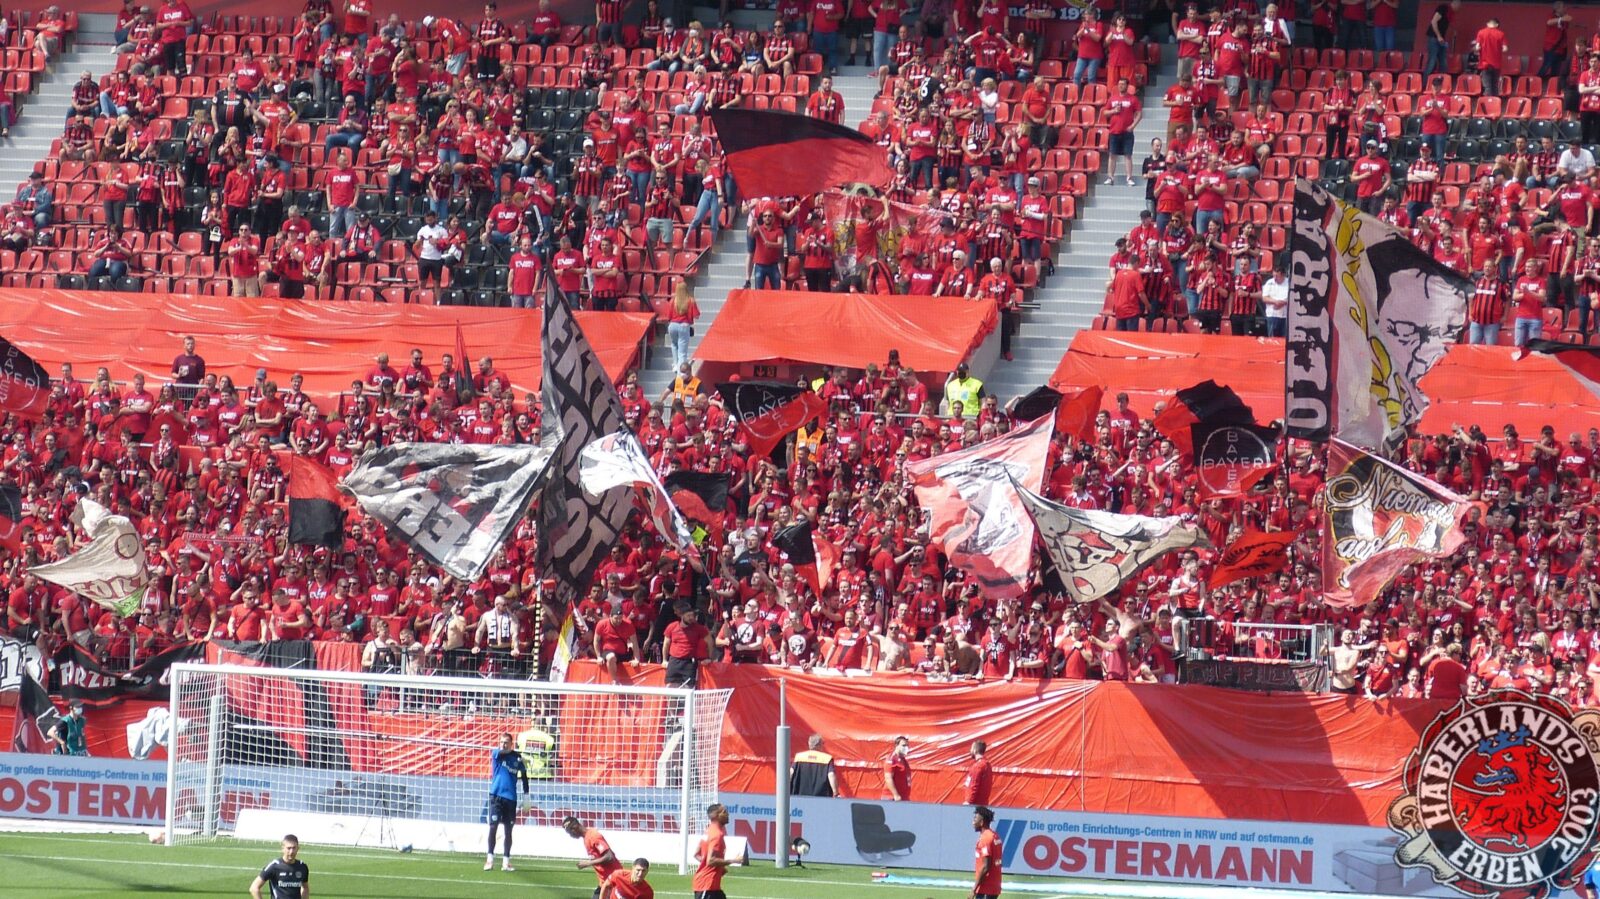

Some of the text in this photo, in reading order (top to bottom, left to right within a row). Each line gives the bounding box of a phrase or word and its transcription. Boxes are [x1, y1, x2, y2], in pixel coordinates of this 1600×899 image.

[1203, 456, 1264, 470] BAYER
[13, 765, 44, 778] großen
[47, 766, 139, 781] Einrichtungs-Centren
[141, 771, 149, 780] in
[1030, 821, 1045, 831] Die
[1047, 822, 1080, 835] großen
[1082, 823, 1181, 838] Einrichtungs-Centren
[1183, 829, 1193, 838] in
[1195, 829, 1217, 840] NRW
[1220, 831, 1237, 841] und
[1240, 832, 1256, 842] auf
[1022, 835, 1314, 885] OSTERMANN
